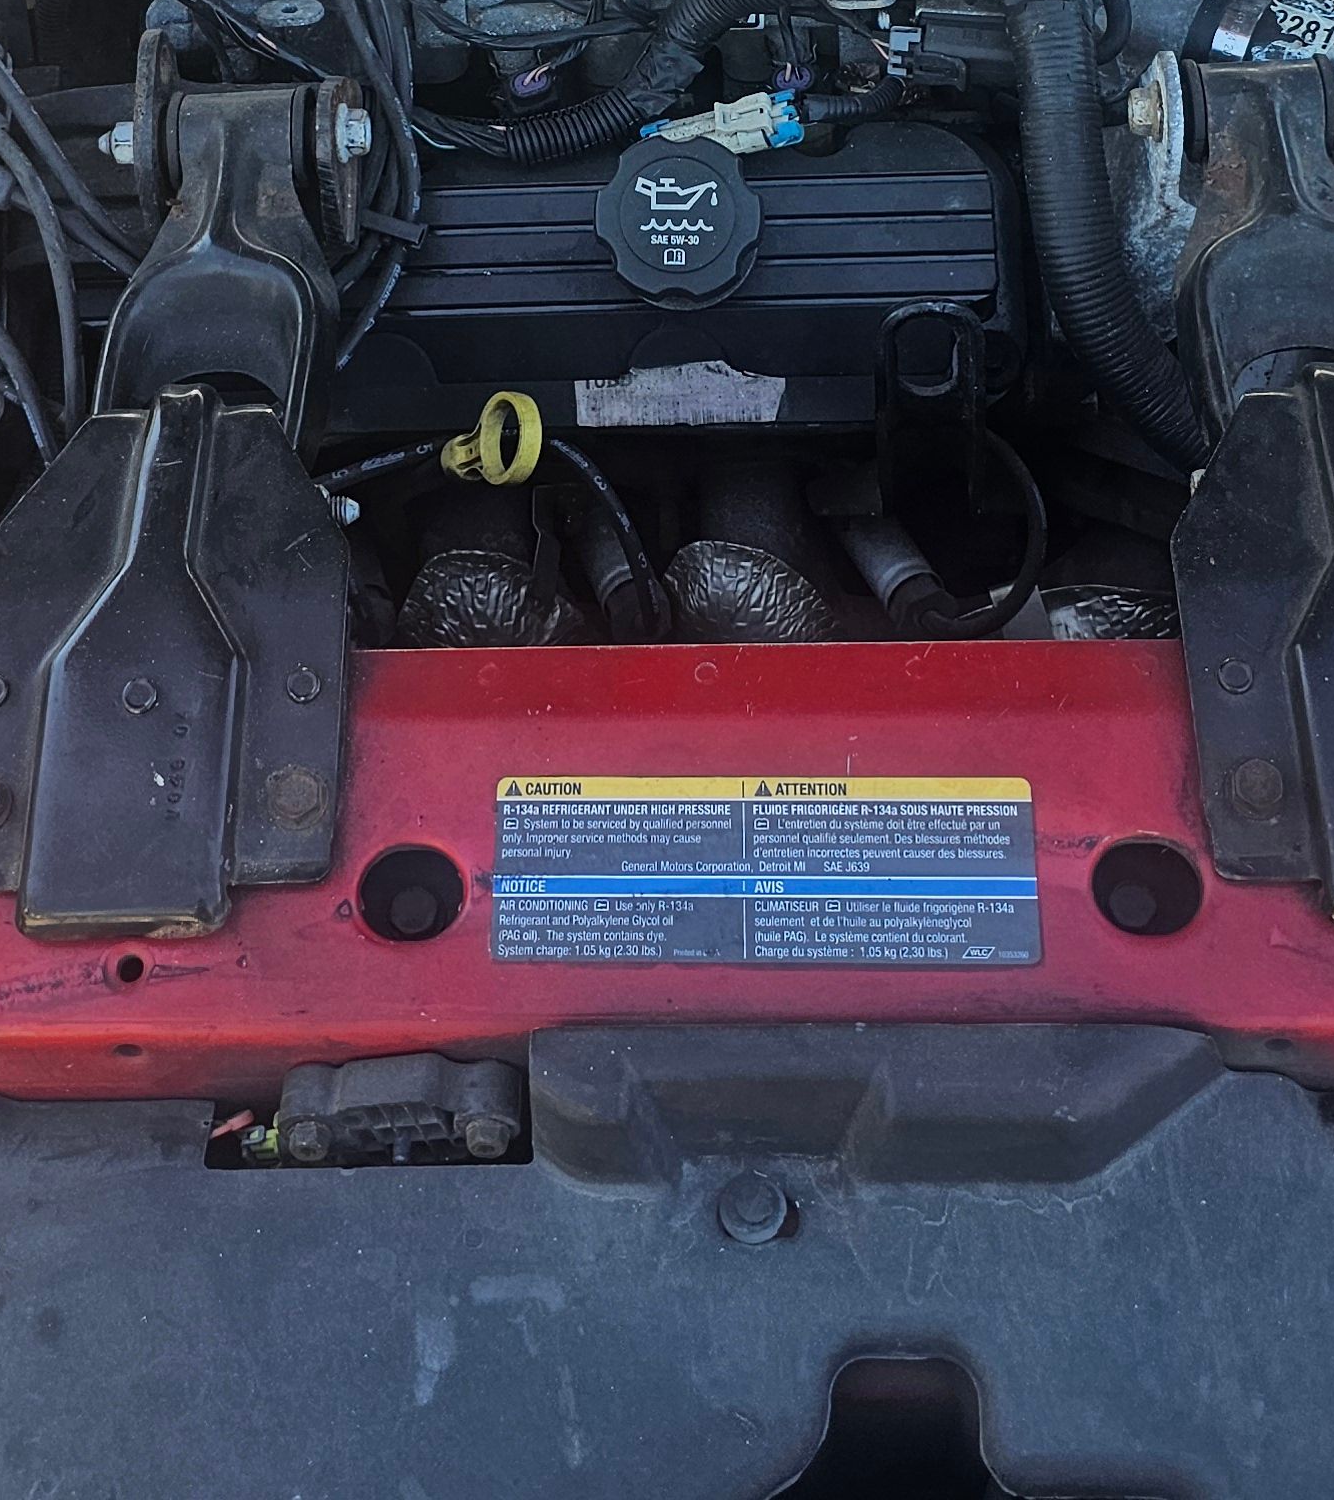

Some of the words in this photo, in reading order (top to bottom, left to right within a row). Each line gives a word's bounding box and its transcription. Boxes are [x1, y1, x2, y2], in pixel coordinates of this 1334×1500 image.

[650, 233, 668, 244] SAE
[670, 234, 699, 245] 5W-30
[525, 782, 582, 796] CAUTION
[775, 783, 847, 796] ATTENTION
[503, 805, 540, 815] R-134a
[542, 804, 612, 815] REFRIGERANT
[613, 804, 648, 815] UNDER
[651, 804, 675, 815] HIGH
[678, 804, 731, 815] PRESSURE
[753, 805, 789, 816] FLUIDE
[792, 802, 858, 816] FRIGORIGÈNE
[861, 805, 898, 816] R-134a
[900, 805, 928, 816] SOUS
[930, 805, 964, 816] HAUTE
[967, 805, 1018, 816] PRESSION
[523, 819, 559, 830] System
[561, 820, 570, 829] to
[572, 819, 584, 829] be
[586, 819, 627, 829] serviced
[629, 819, 640, 831] by
[643, 818, 683, 831] qualified
[686, 819, 732, 830] personnel
[777, 819, 827, 830] L'entretien
[830, 819, 841, 830] du
[844, 819, 884, 831] système
[886, 819, 905, 830] doit
[907, 819, 926, 830] être
[928, 818, 967, 830] effectué
[969, 821, 985, 832] par
[988, 821, 1000, 830] un
[503, 833, 523, 845] only.
[570, 834, 604, 844] service
[607, 834, 648, 844] methods
[650, 834, 671, 845] may
[673, 835, 701, 844] cause
[753, 833, 800, 846] personnel
[802, 833, 837, 846] qualifié
[839, 833, 892, 845] seulement.
[894, 834, 913, 844] Des
[916, 834, 961, 845] blessures
[963, 834, 1011, 845] méthodes
[501, 847, 542, 859] personal
[544, 847, 573, 860] injury.
[621, 861, 658, 872] General
[660, 861, 693, 872] Motors
[696, 861, 754, 873] Corporation,
[759, 861, 791, 872] Detroit
[794, 861, 805, 872] MI
[823, 861, 844, 872] SAE
[846, 861, 870, 872] J639
[500, 880, 546, 893] NOTICE
[754, 880, 784, 893] AVIS
[499, 900, 515, 911] AIR
[518, 900, 588, 911] CONDITIONING
[615, 900, 633, 912] Use
[658, 901, 694, 912] R-134a
[754, 900, 819, 912] CLIMATISEUR
[846, 902, 879, 913] Utiliser
[882, 902, 891, 913] le
[893, 902, 920, 913] fluide
[922, 902, 975, 915] frigorigène
[977, 902, 1014, 914] R-134a
[499, 915, 550, 928] Refrigerant
[552, 915, 570, 925] and
[572, 915, 630, 928] Polyalkylene
[632, 915, 660, 928] Glycol
[662, 915, 674, 926] oil
[498, 930, 520, 942] (PAG
[522, 930, 540, 942] oil).
[547, 930, 564, 941] The
[567, 931, 601, 943] system
[603, 930, 644, 941] contains
[646, 930, 667, 943] dye.
[498, 945, 533, 957] System
[535, 945, 572, 958] charge:
[575, 945, 596, 956] 1.05
[599, 945, 611, 958] kg
[613, 945, 639, 957] (2.30
[641, 945, 662, 957] lbs.)
[754, 946, 790, 959] Charge
[792, 946, 804, 957] du
[806, 945, 848, 959] système
[884, 947, 897, 959] kg
[927, 947, 949, 959] lbs.)
